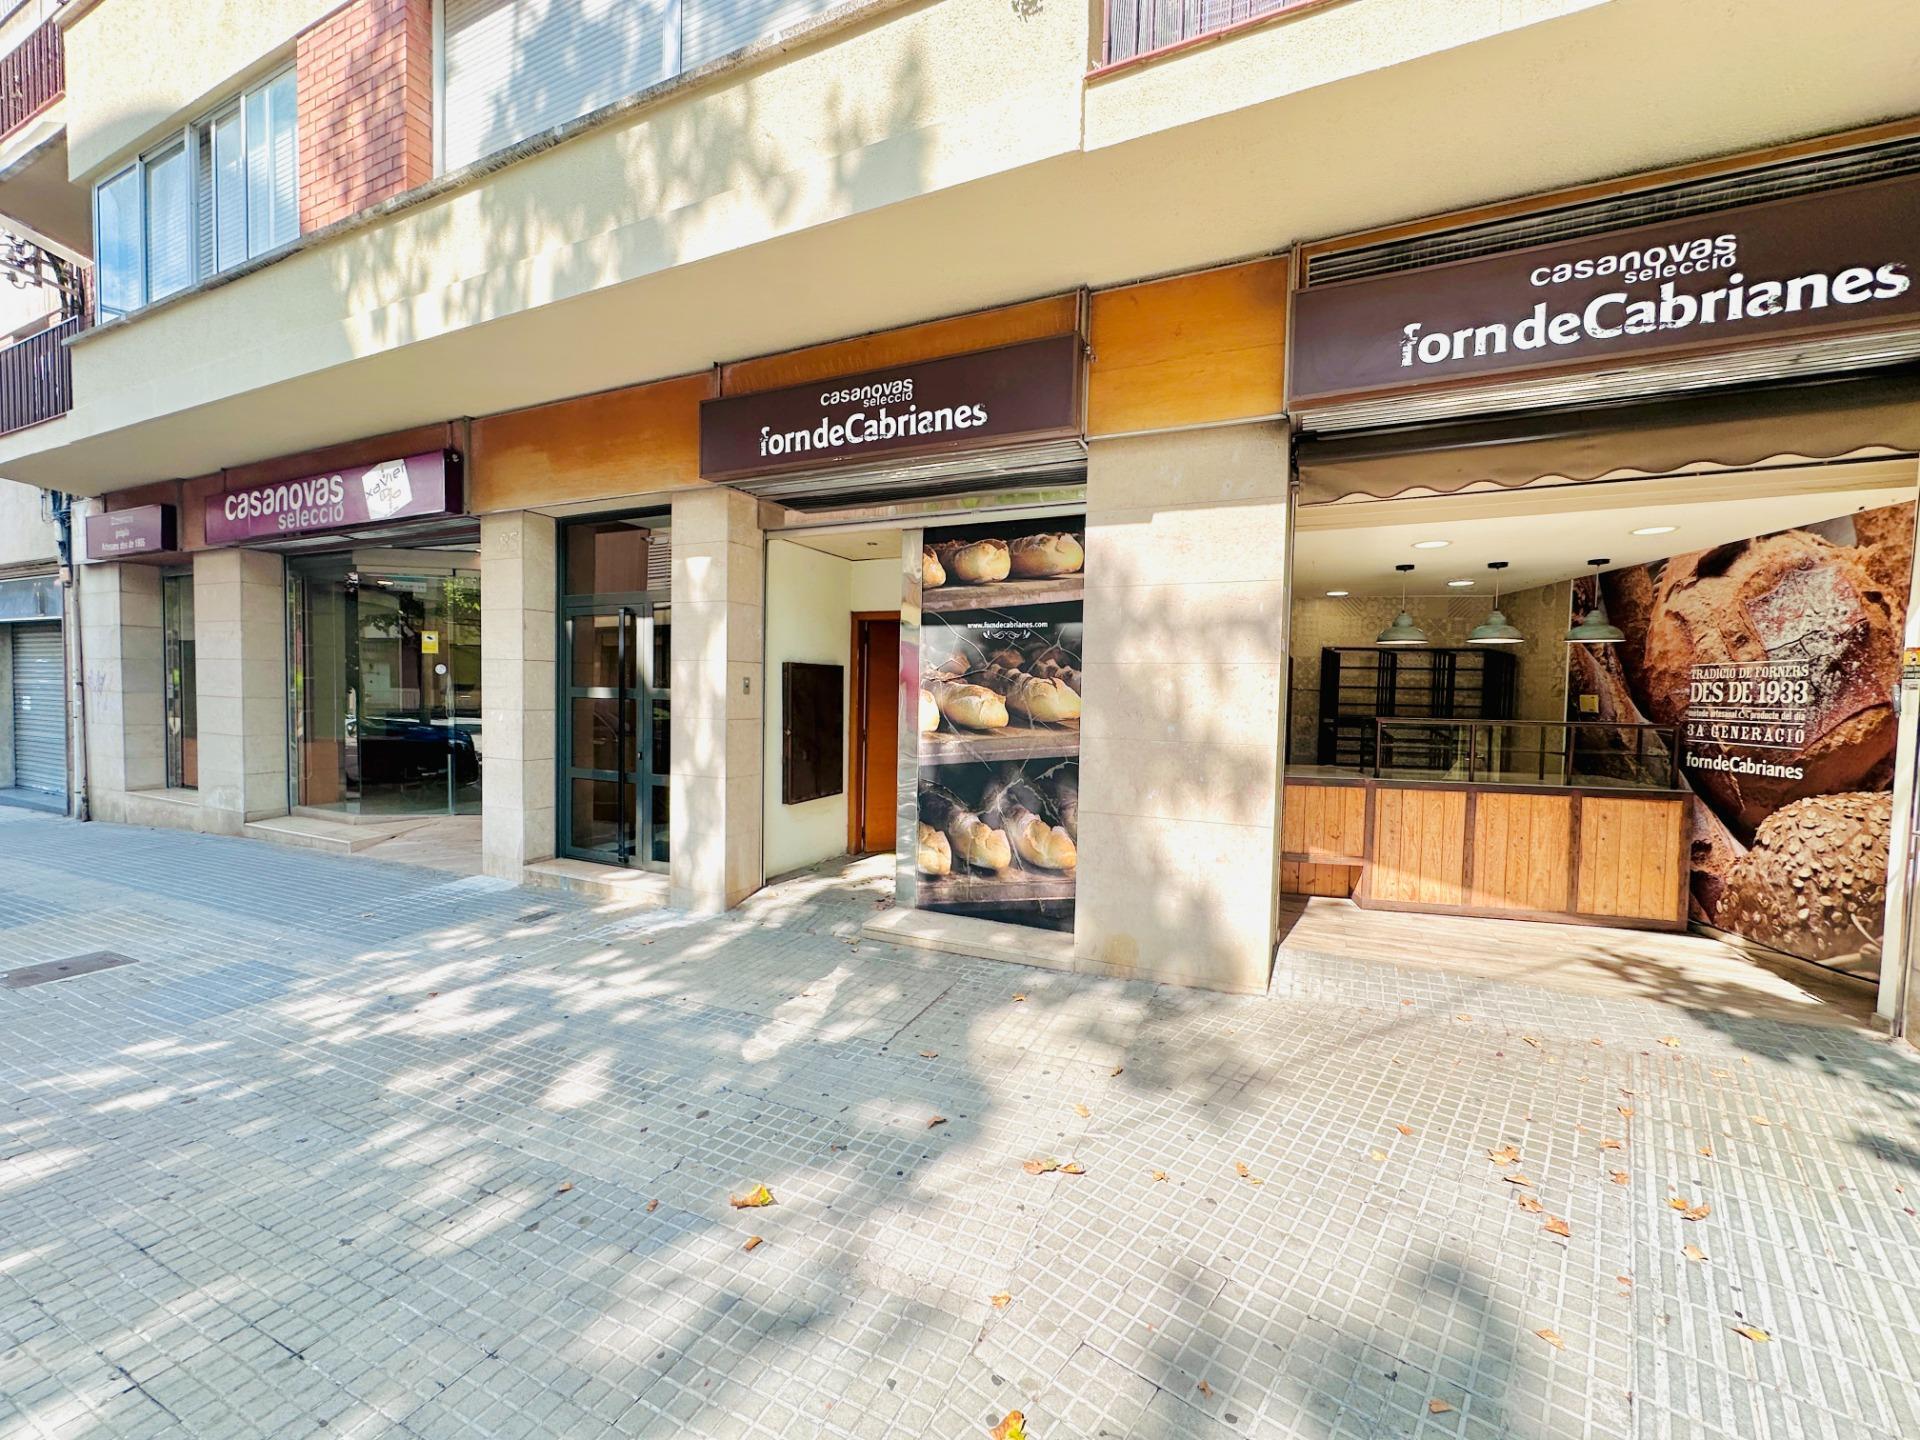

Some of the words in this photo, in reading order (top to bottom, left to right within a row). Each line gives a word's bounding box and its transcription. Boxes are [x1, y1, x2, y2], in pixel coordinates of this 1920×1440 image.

[1530, 233, 1737, 287] casanovas
[820, 378, 913, 406] casanovas
[225, 475, 344, 521] casanovas
[278, 500, 344, 530] selecció
[1739, 667, 1753, 678] DE
[1755, 664, 1809, 678] FORNERS
[1690, 682, 1724, 703] DES
[1728, 682, 1753, 703] DE
[1758, 680, 1809, 704] 1933
[1781, 711, 1793, 720] del
[1687, 723, 1704, 737] 3A
[1711, 724, 1805, 744] GENERACIÓ
[1686, 751, 1804, 780] forndeCabrianes
